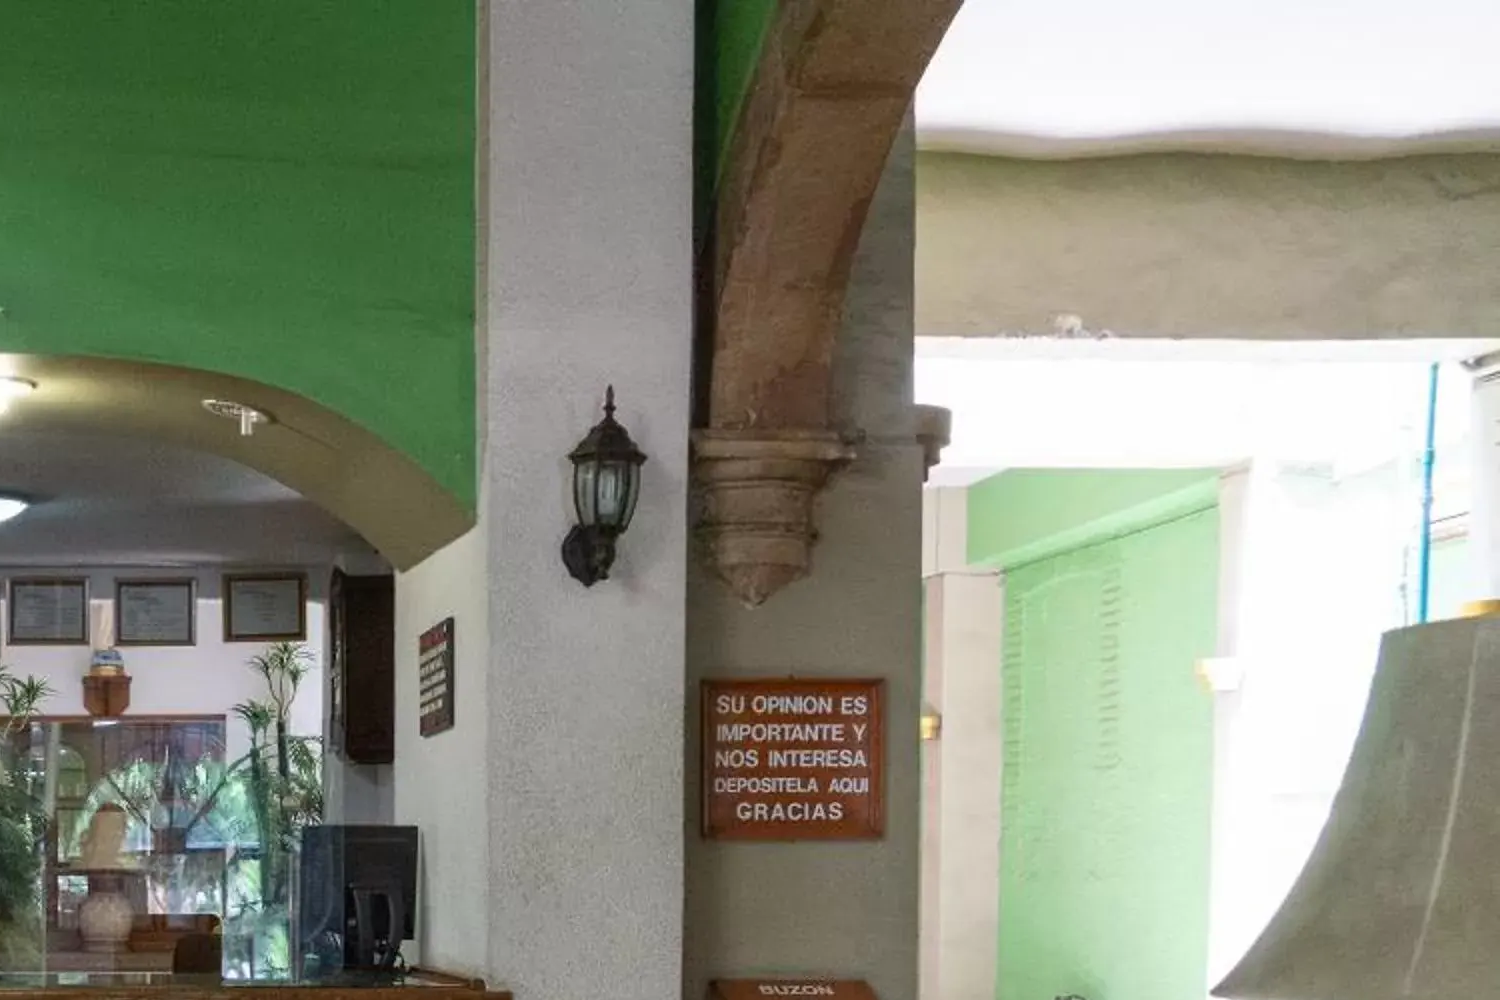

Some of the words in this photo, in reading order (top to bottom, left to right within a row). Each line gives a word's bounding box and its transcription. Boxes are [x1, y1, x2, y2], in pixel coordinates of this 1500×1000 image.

[716, 695, 745, 715] SU
[751, 695, 832, 715] OPINION
[841, 696, 868, 715] ES
[716, 723, 845, 742] IMPORTANTE
[852, 723, 868, 742] Y
[714, 749, 759, 768] NOS
[768, 749, 867, 768] INTERESA
[714, 777, 819, 794] DEPOSITELA
[828, 777, 869, 794] AQUI
[736, 802, 844, 822] GRACIAS
[758, 984, 835, 996] BUZON
